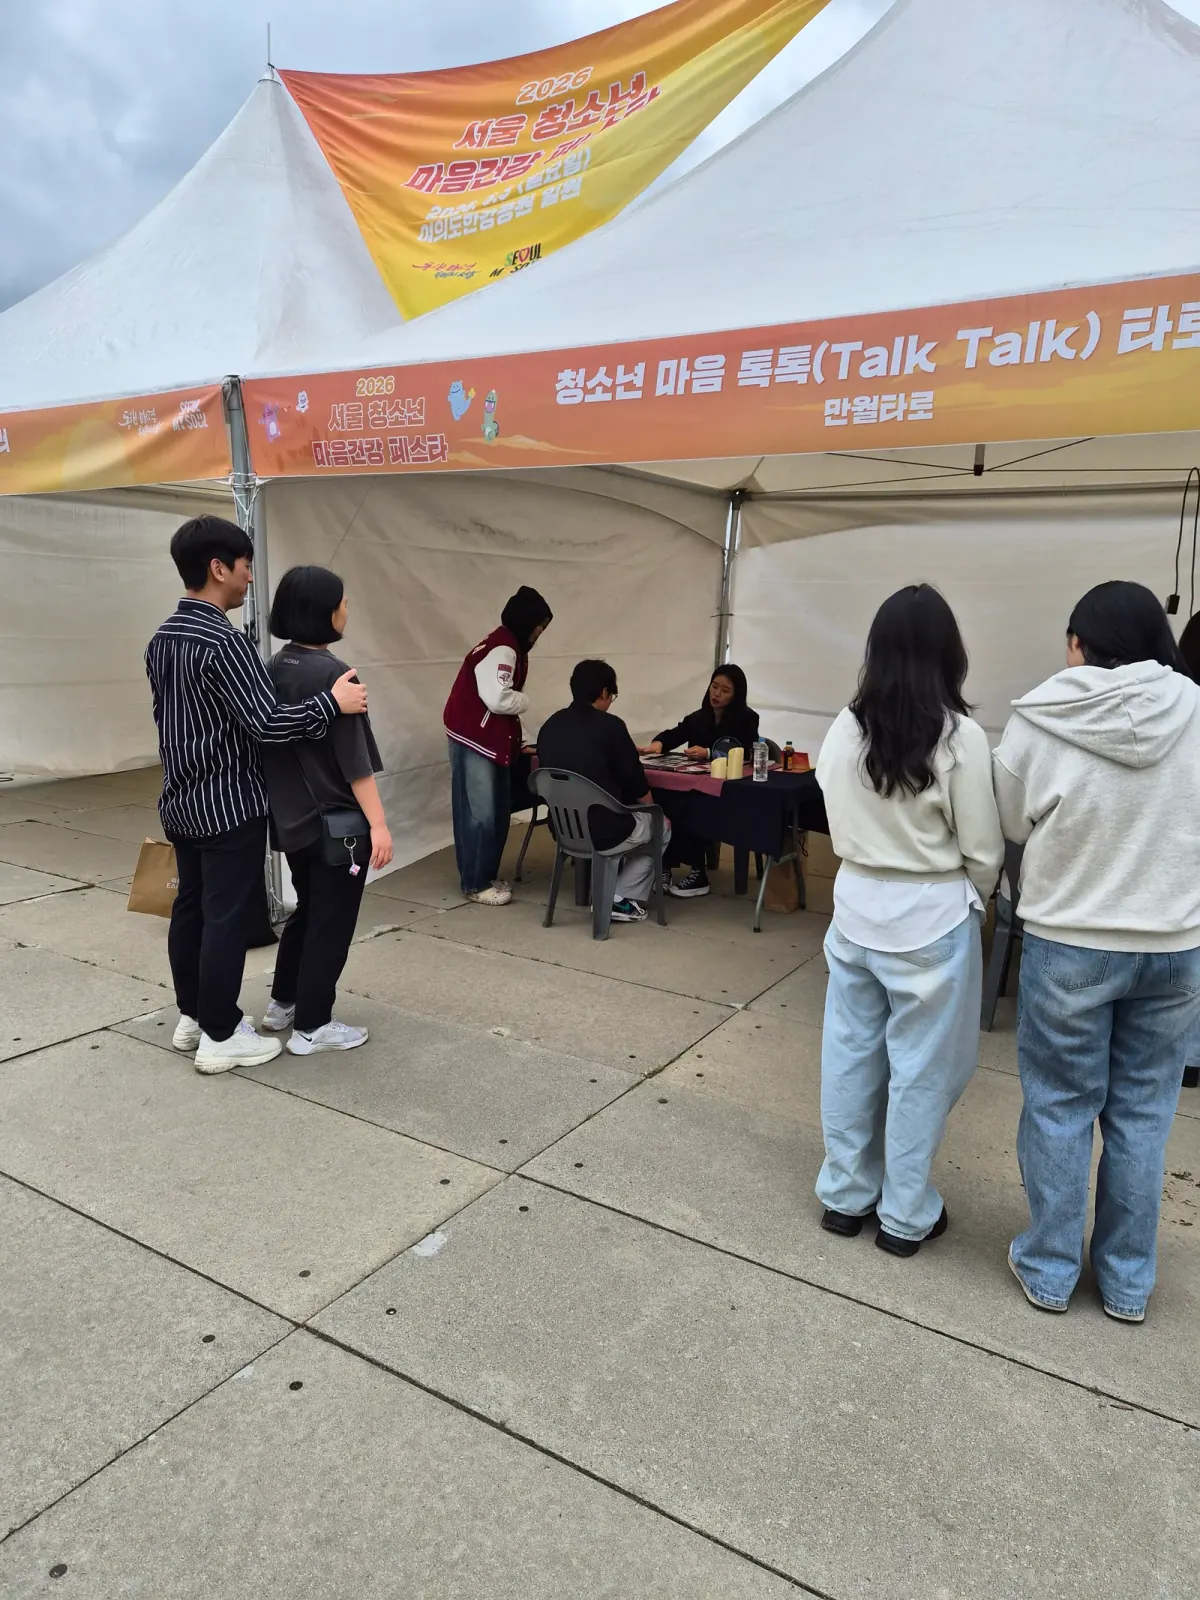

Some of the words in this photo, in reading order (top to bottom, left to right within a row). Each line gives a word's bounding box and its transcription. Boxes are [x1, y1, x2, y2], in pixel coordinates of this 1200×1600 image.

[516, 67, 594, 105] 2026
[453, 113, 527, 149] 서울
[531, 71, 648, 142] 청소년
[402, 150, 544, 194] 마음건강
[555, 362, 646, 405] 청소년
[655, 354, 726, 397] 마음
[737, 334, 939, 388] 톡톡(Talk
[956, 310, 1101, 369] Talk)
[356, 375, 395, 397] 2026
[328, 403, 364, 432] 서울
[368, 397, 426, 430] 청소년
[824, 390, 935, 427] 만월타로
[312, 438, 384, 468] 마음건강
[388, 433, 449, 465] 페스타
